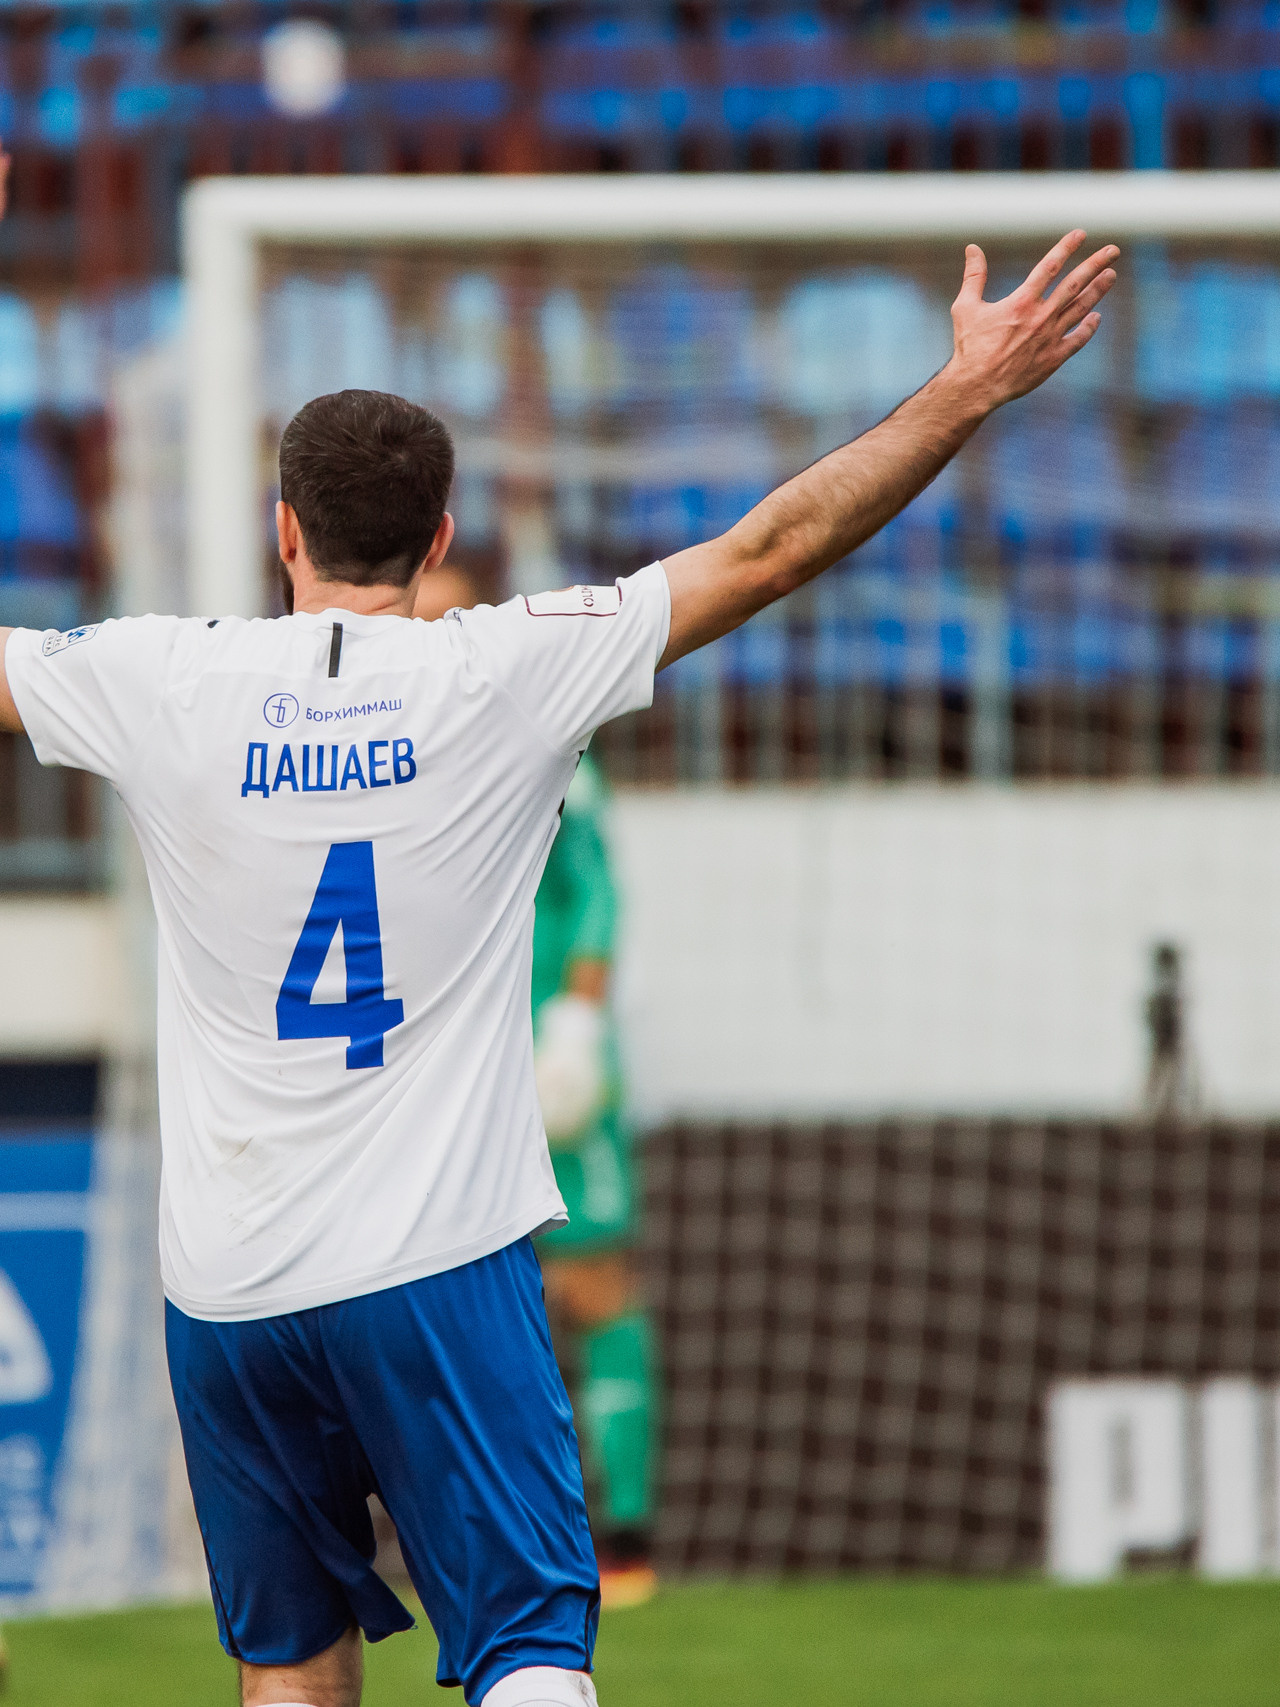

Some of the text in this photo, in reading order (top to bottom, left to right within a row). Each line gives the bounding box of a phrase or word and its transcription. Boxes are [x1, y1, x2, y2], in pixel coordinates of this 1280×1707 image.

[305, 699, 402, 723] БОРХИММАШ
[241, 737, 417, 799] ДАШАЕВ
[275, 840, 405, 1070] 4
